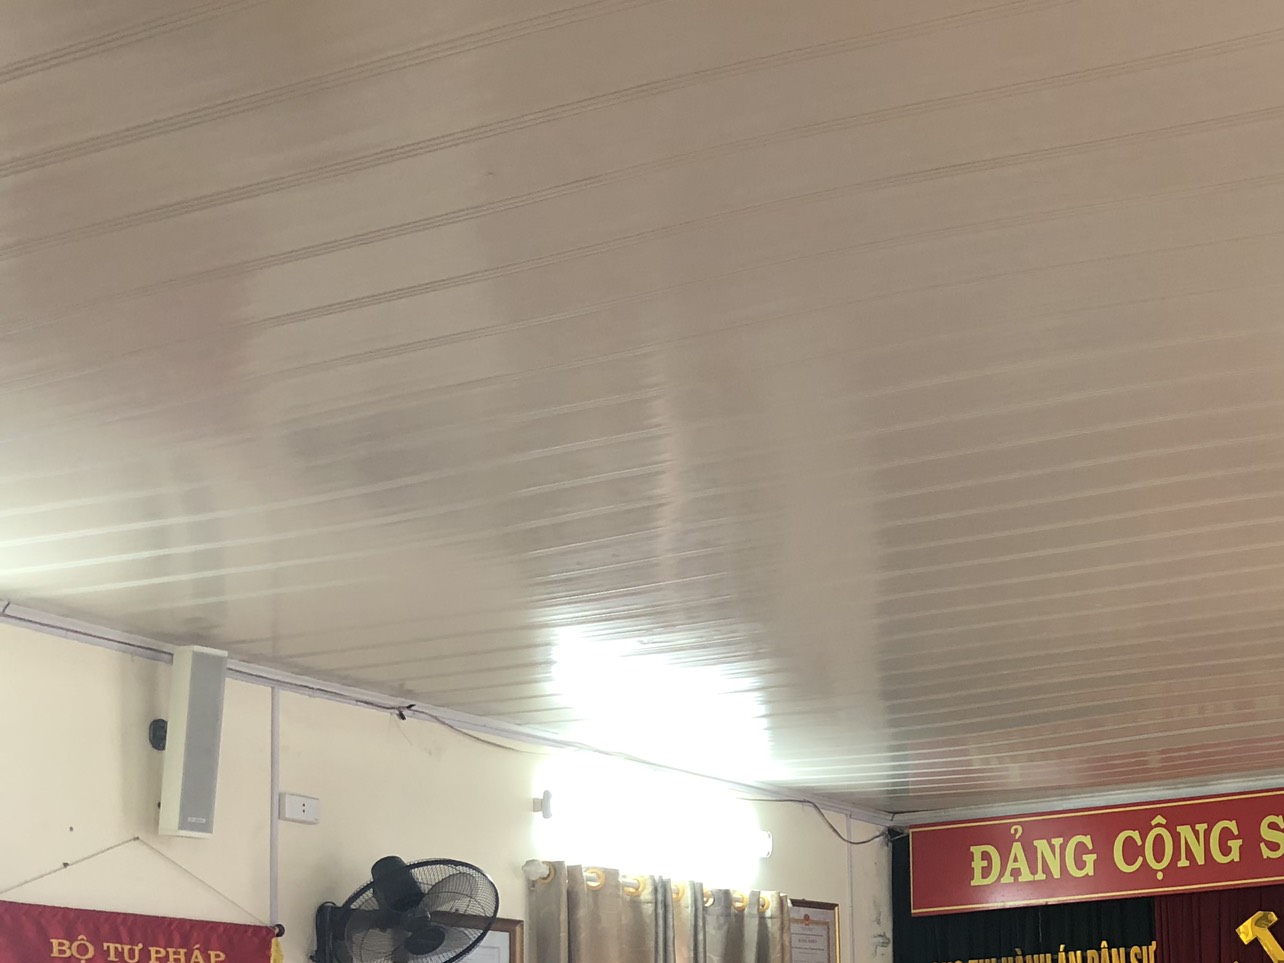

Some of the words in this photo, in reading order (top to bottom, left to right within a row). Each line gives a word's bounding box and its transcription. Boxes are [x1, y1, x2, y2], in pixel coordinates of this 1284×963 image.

[970, 825, 1097, 886] ĐẢNG
[1113, 815, 1243, 880] CỘNG
[49, 934, 95, 963] BỘ
[103, 942, 143, 963] TƯ
